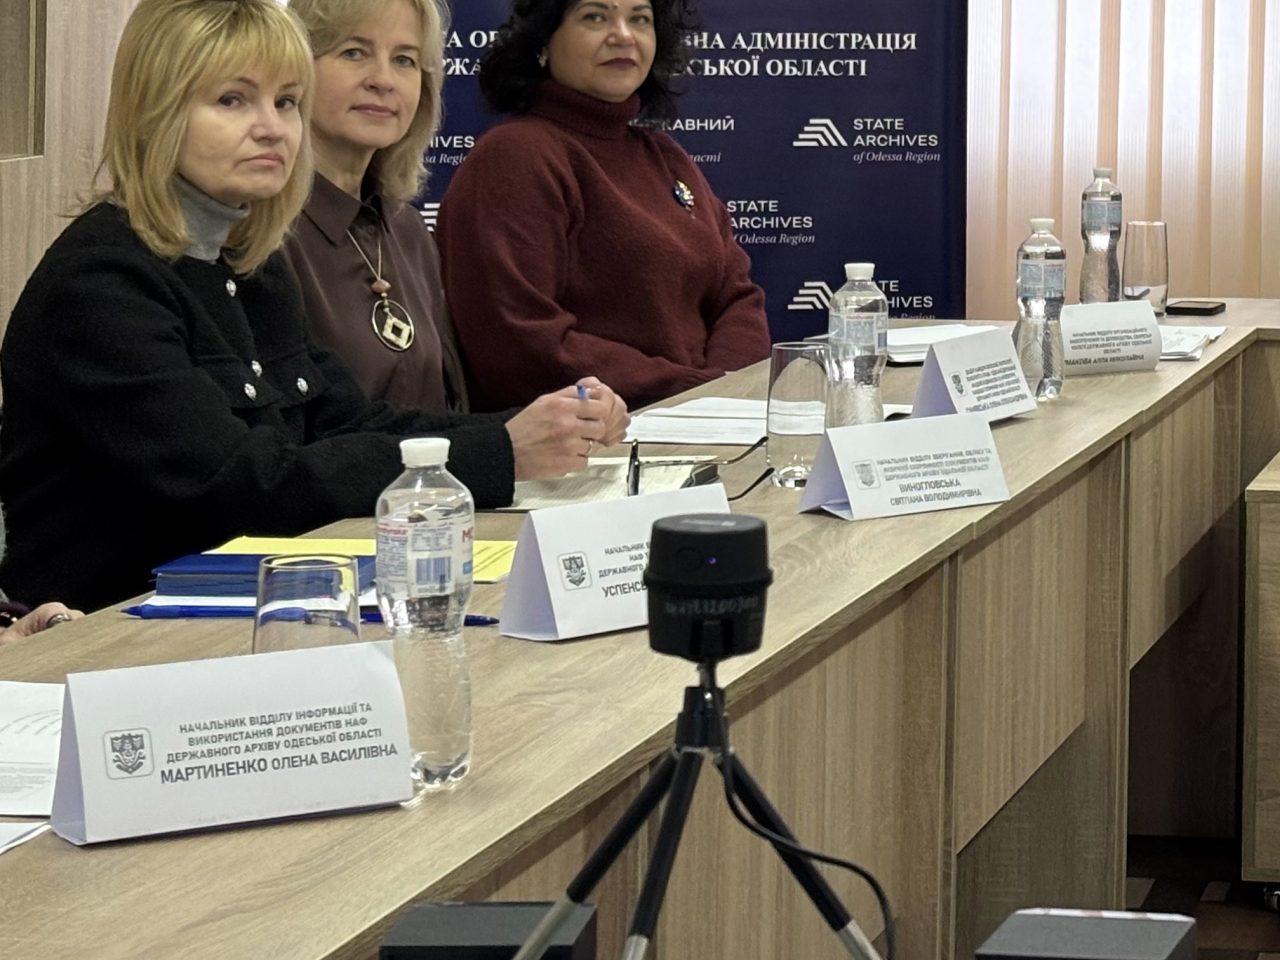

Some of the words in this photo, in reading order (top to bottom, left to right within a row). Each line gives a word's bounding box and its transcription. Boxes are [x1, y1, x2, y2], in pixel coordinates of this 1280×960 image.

[731, 32, 917, 53] АДМІНІСТРАЦІЯ
[686, 55, 760, 76] СЬКОЇ
[765, 59, 867, 77] ОБЛАСТІ
[853, 118, 904, 130] STATE
[853, 134, 938, 147] ARCHIVES
[853, 151, 866, 164] of
[866, 151, 903, 162] Odessa
[905, 151, 941, 163] Region
[727, 200, 779, 212] STATE
[730, 216, 813, 229] ARCHIVES
[739, 233, 776, 244] Odessa
[779, 233, 815, 246] Region
[605, 543, 644, 556] НАЧАЛЬНИК
[629, 553, 644, 561] НАФ
[599, 563, 644, 578] ДЕРЖАВНОГО
[601, 580, 648, 598] УСПЕНСЬ
[179, 717, 247, 734] НАЧАЛЬНИК
[249, 711, 293, 727] ВІДДІЛУ
[295, 704, 358, 722] ІНФОРМАЦІЇ
[359, 702, 373, 713] ТА
[187, 727, 274, 747] ВИКОРИСТАННЯ
[276, 721, 342, 738] ДОКУМЕНТІВ
[344, 717, 368, 729] НАФ
[166, 744, 241, 764] ДЕРЖАВНОГО
[243, 740, 281, 755] АРХІВУ
[283, 732, 337, 751] ОДЕСЬКОЇ
[339, 728, 382, 743] ОБЛАСТІ
[160, 759, 268, 784] МАРТИНЕНКО
[271, 753, 318, 772] ОЛЕНА
[321, 743, 398, 766] ВАСИЛІВНА
